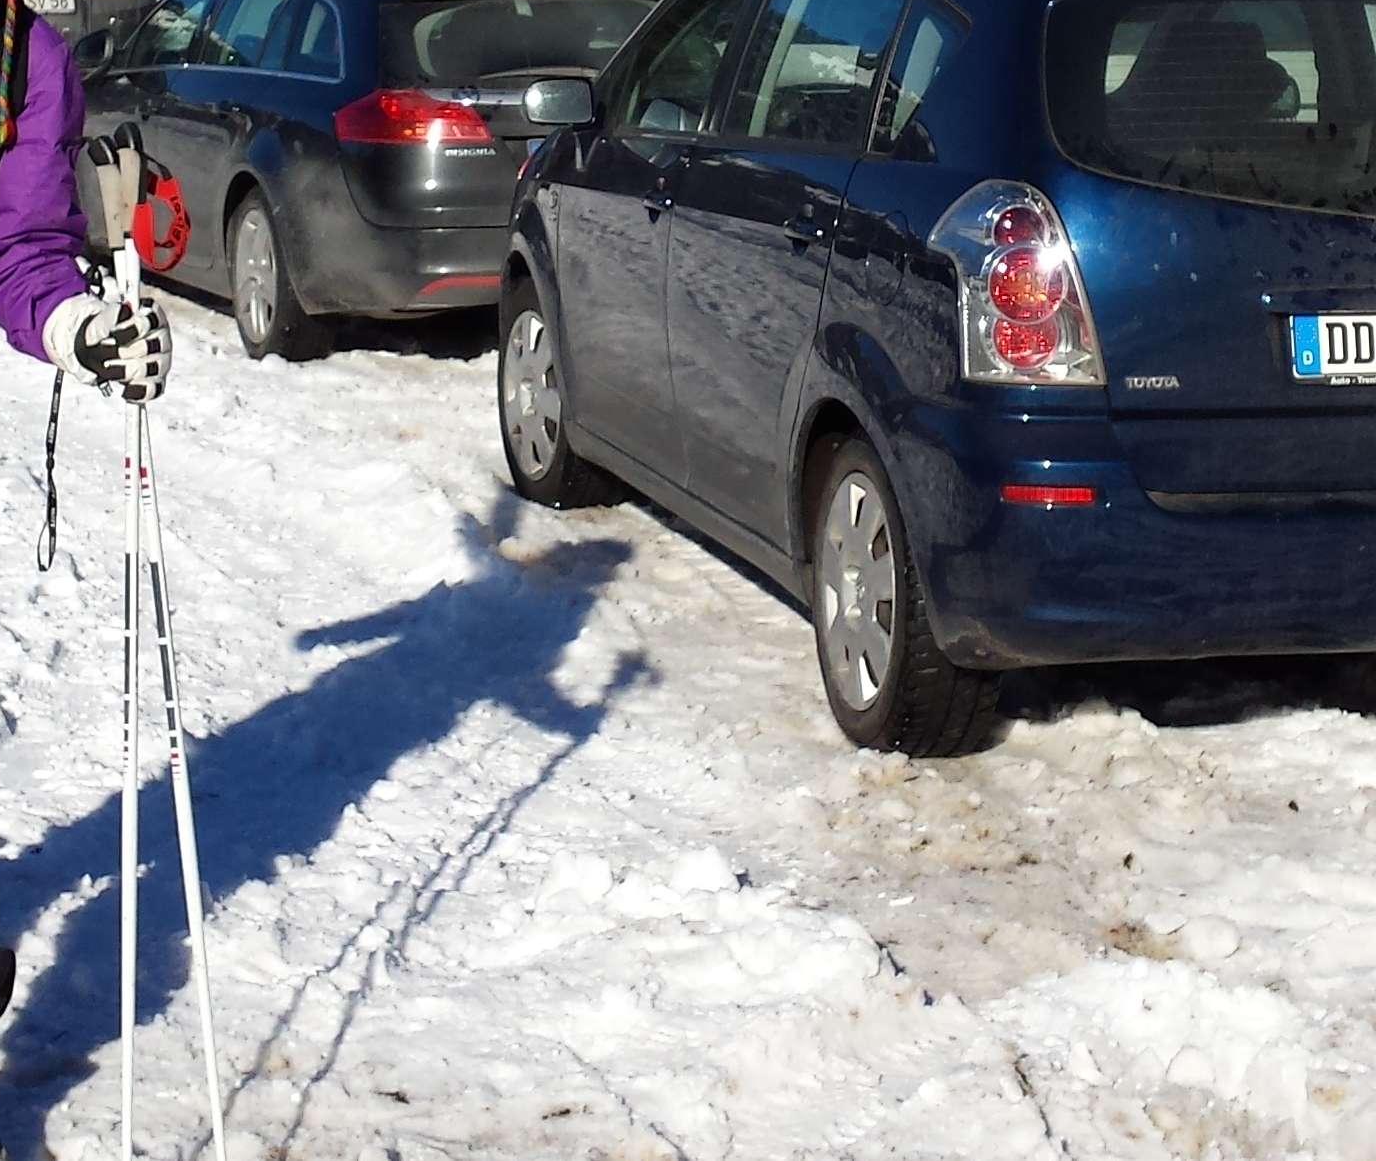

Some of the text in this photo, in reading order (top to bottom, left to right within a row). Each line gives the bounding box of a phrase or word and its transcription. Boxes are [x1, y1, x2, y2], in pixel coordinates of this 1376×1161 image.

[444, 148, 496, 157] INSIGNIA
[1326, 321, 1375, 365] DD
[1302, 350, 1314, 366] D
[1125, 376, 1180, 388] TOYOTA
